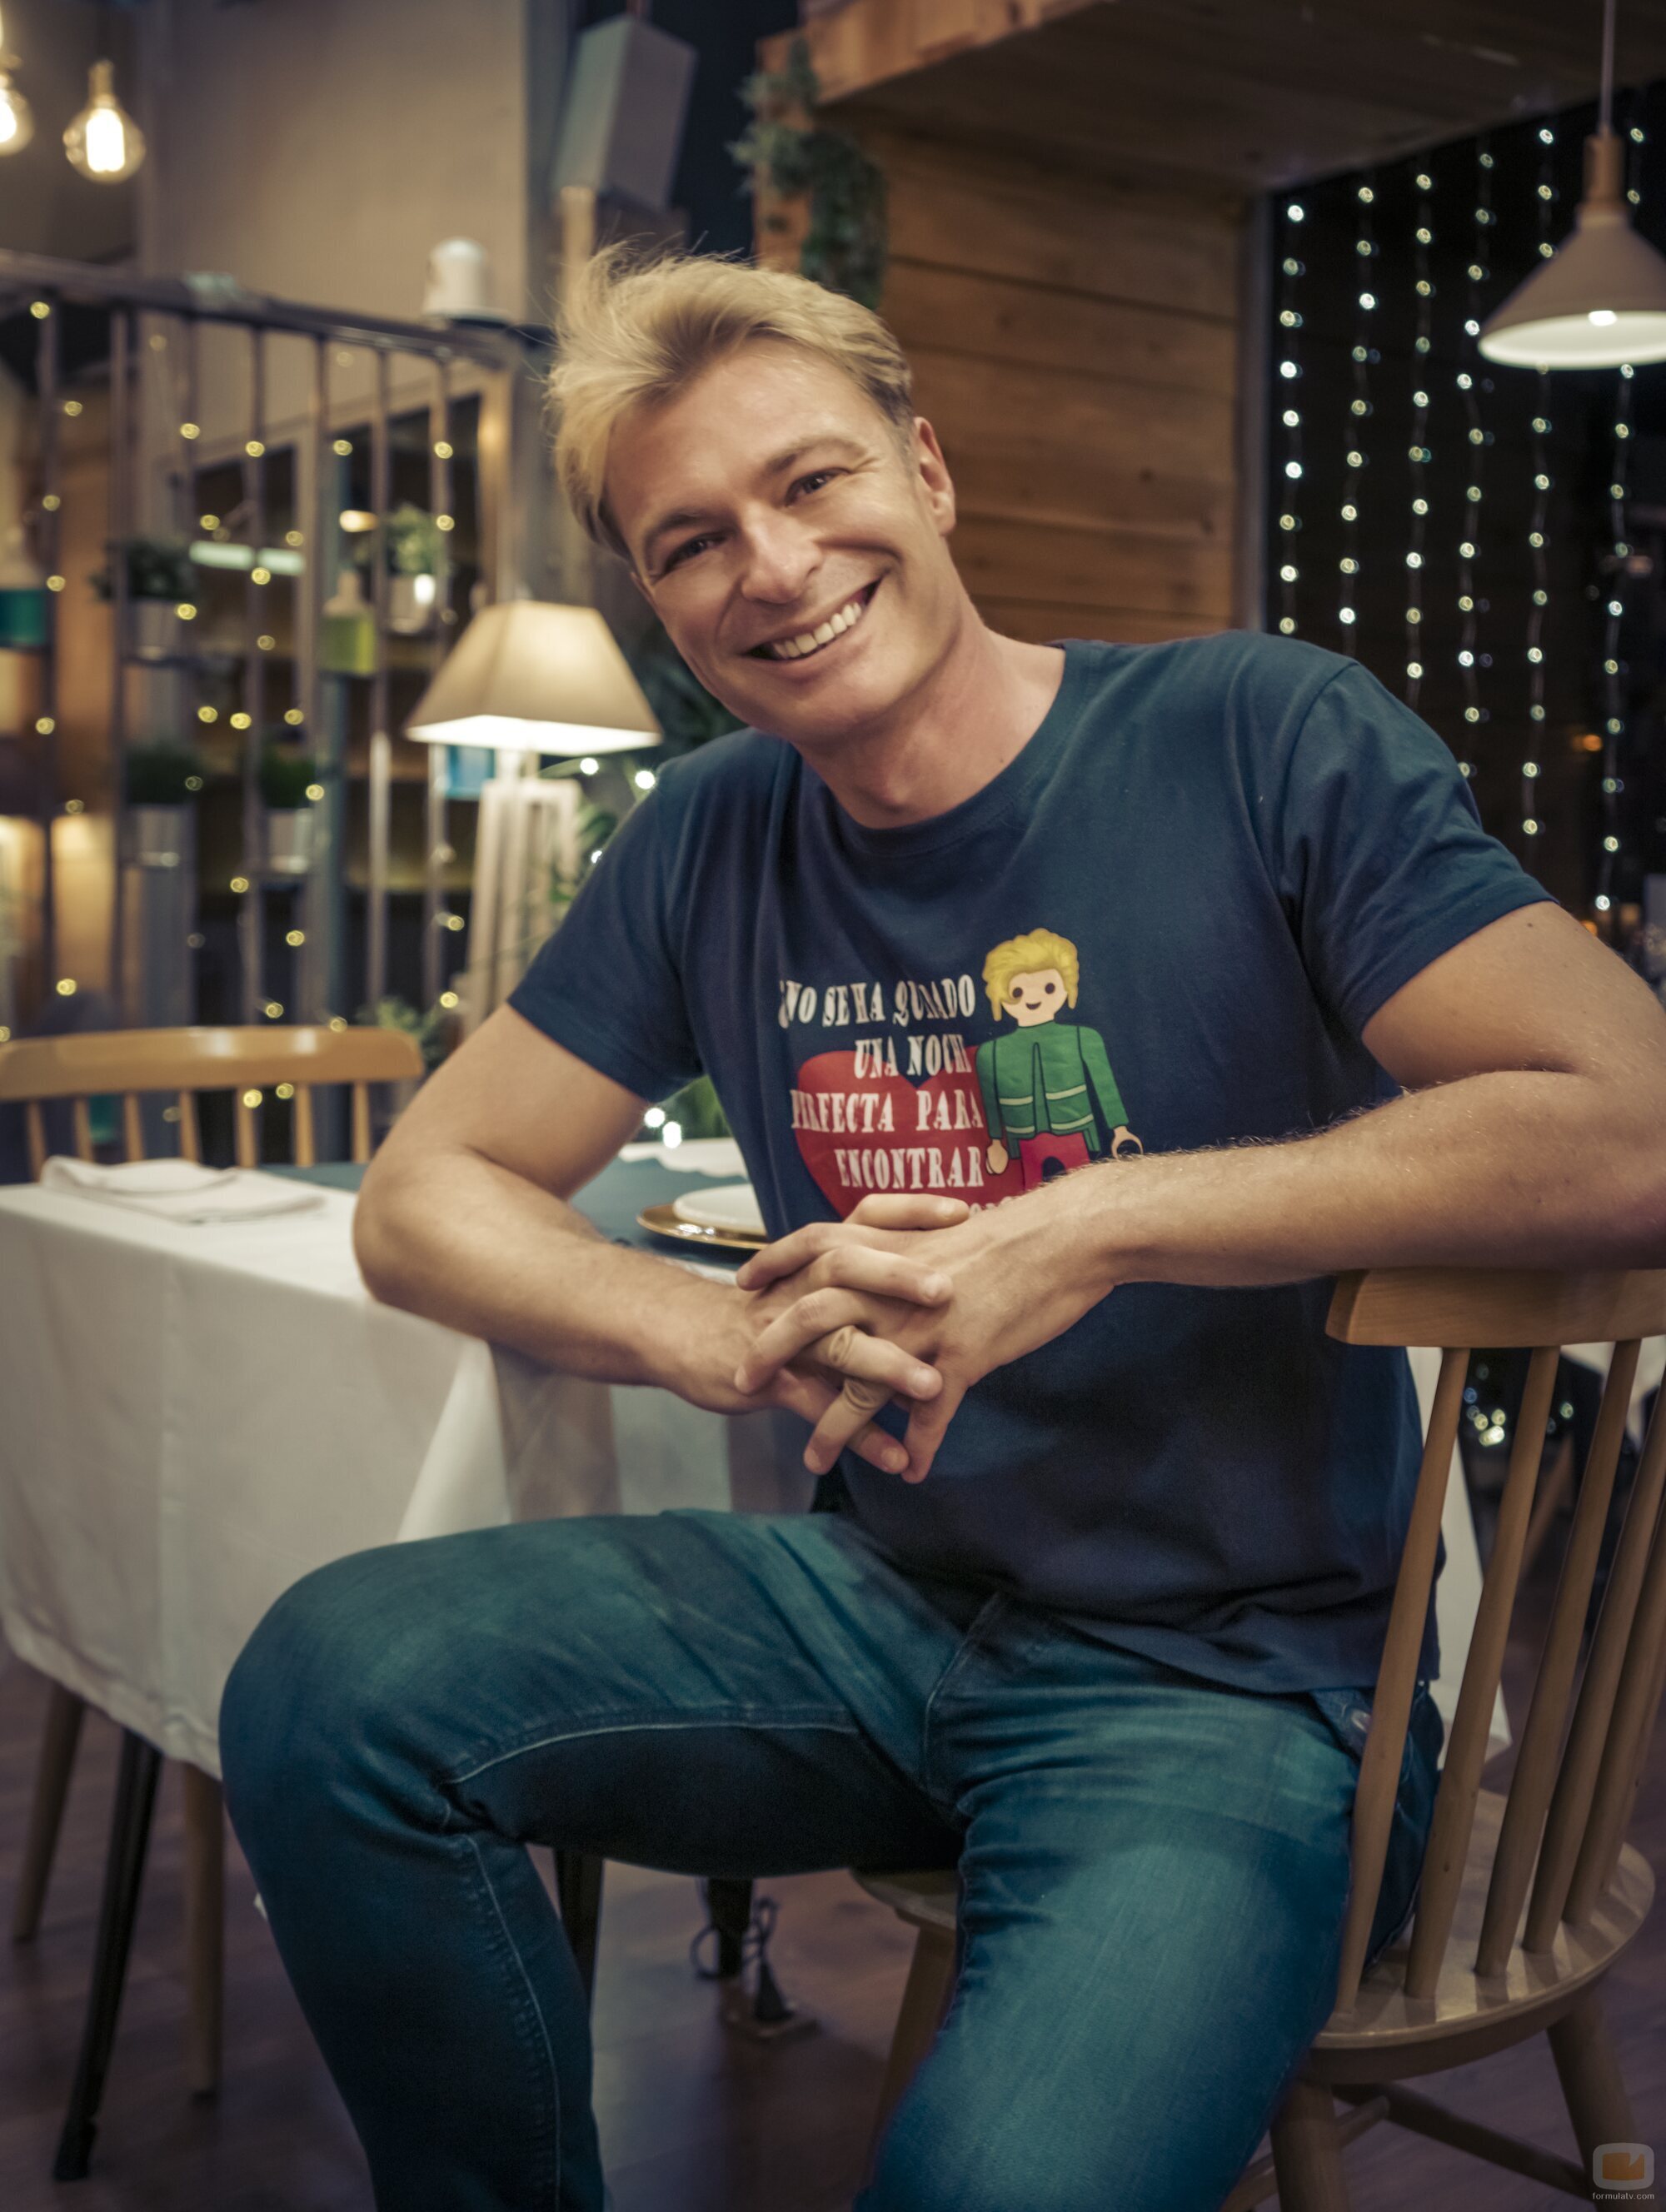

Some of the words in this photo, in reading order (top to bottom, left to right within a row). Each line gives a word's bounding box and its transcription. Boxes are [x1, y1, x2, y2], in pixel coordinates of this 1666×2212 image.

[822, 984, 850, 1028] SE
[850, 981, 885, 1024] HA
[853, 1035, 899, 1079] UNA
[915, 1089, 984, 1131] PARA
[834, 1145, 985, 1189] ENCONTRAR
